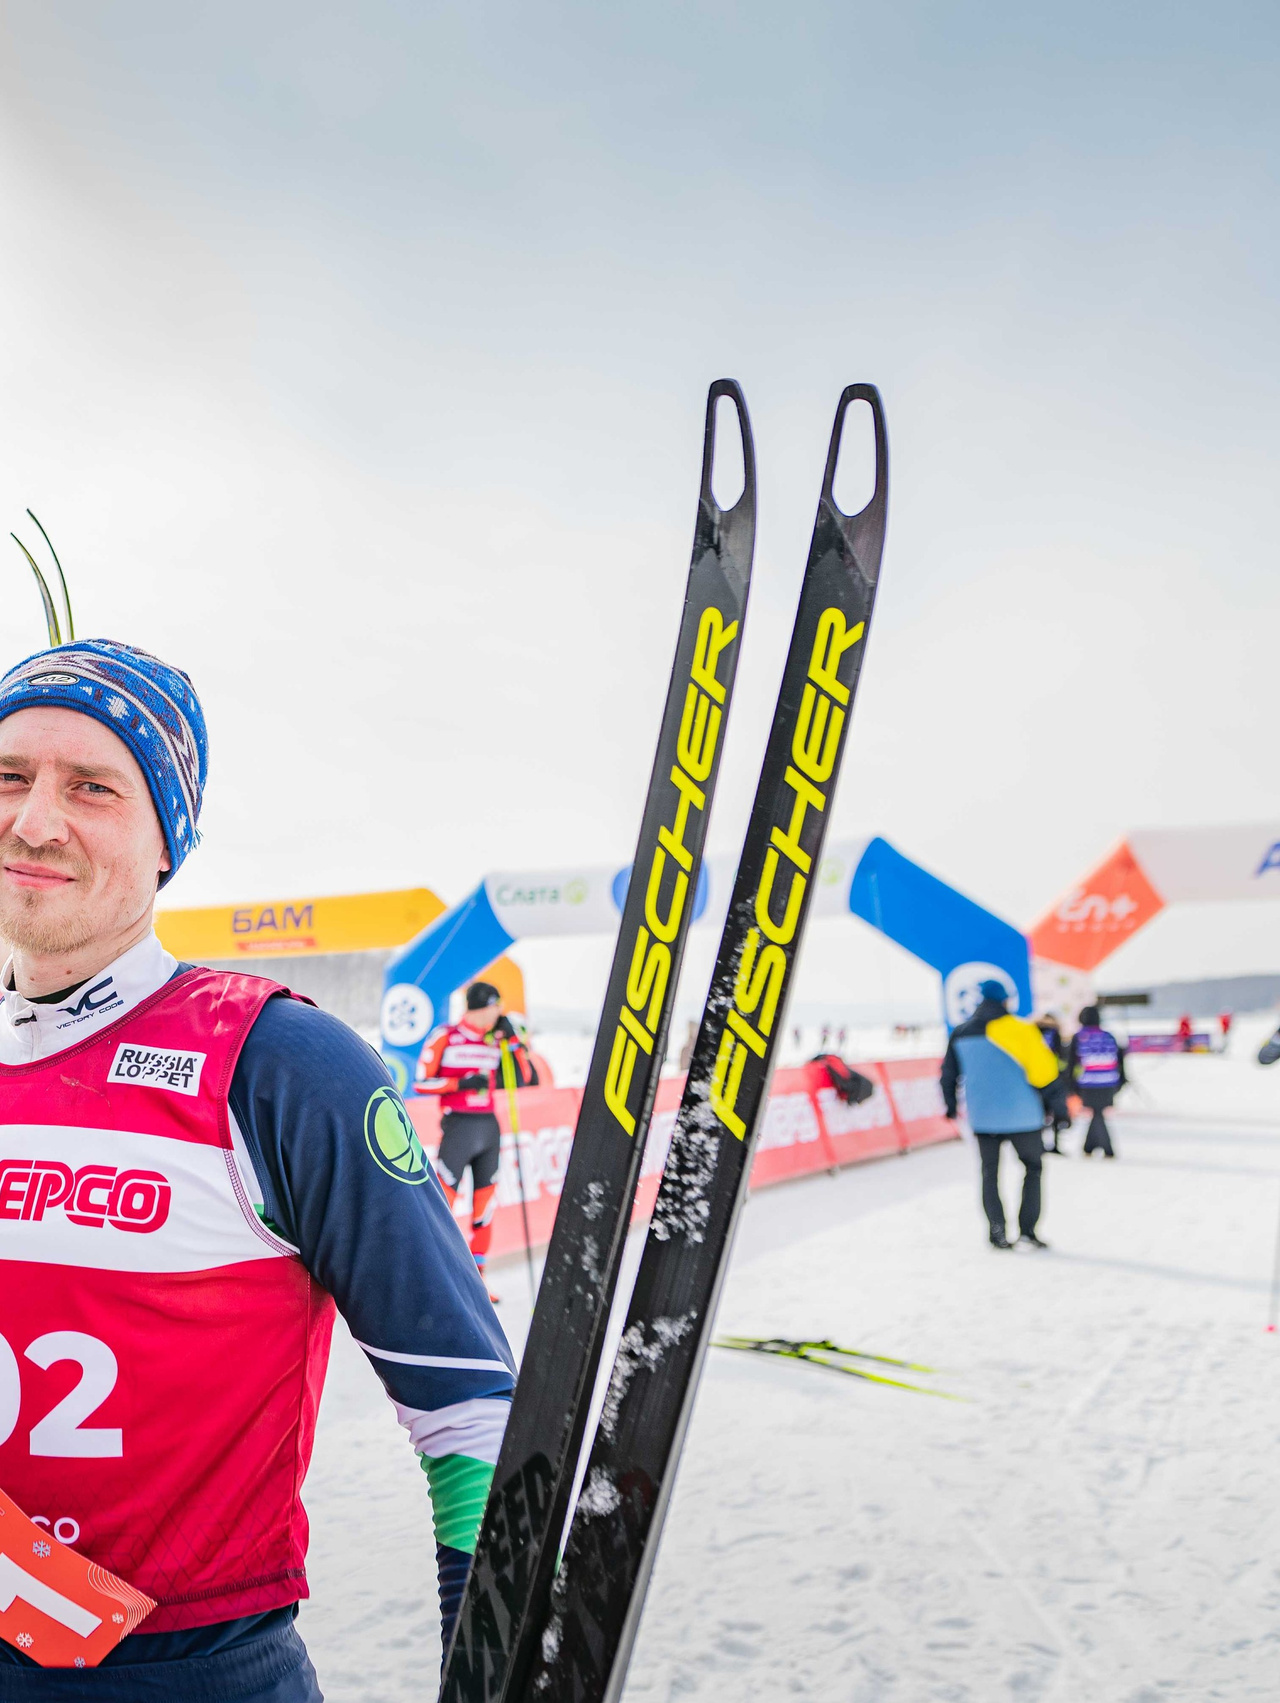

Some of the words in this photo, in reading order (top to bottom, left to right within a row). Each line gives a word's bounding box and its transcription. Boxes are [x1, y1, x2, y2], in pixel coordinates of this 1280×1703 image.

[604, 607, 738, 1137] FISCHER
[711, 607, 865, 1141] FISCHER
[233, 905, 314, 933] БАМ
[56, 1012, 95, 1030] VICTORY
[98, 999, 124, 1014] CODE
[120, 1048, 195, 1073] RUSSIA
[115, 1063, 194, 1088] LOPPET
